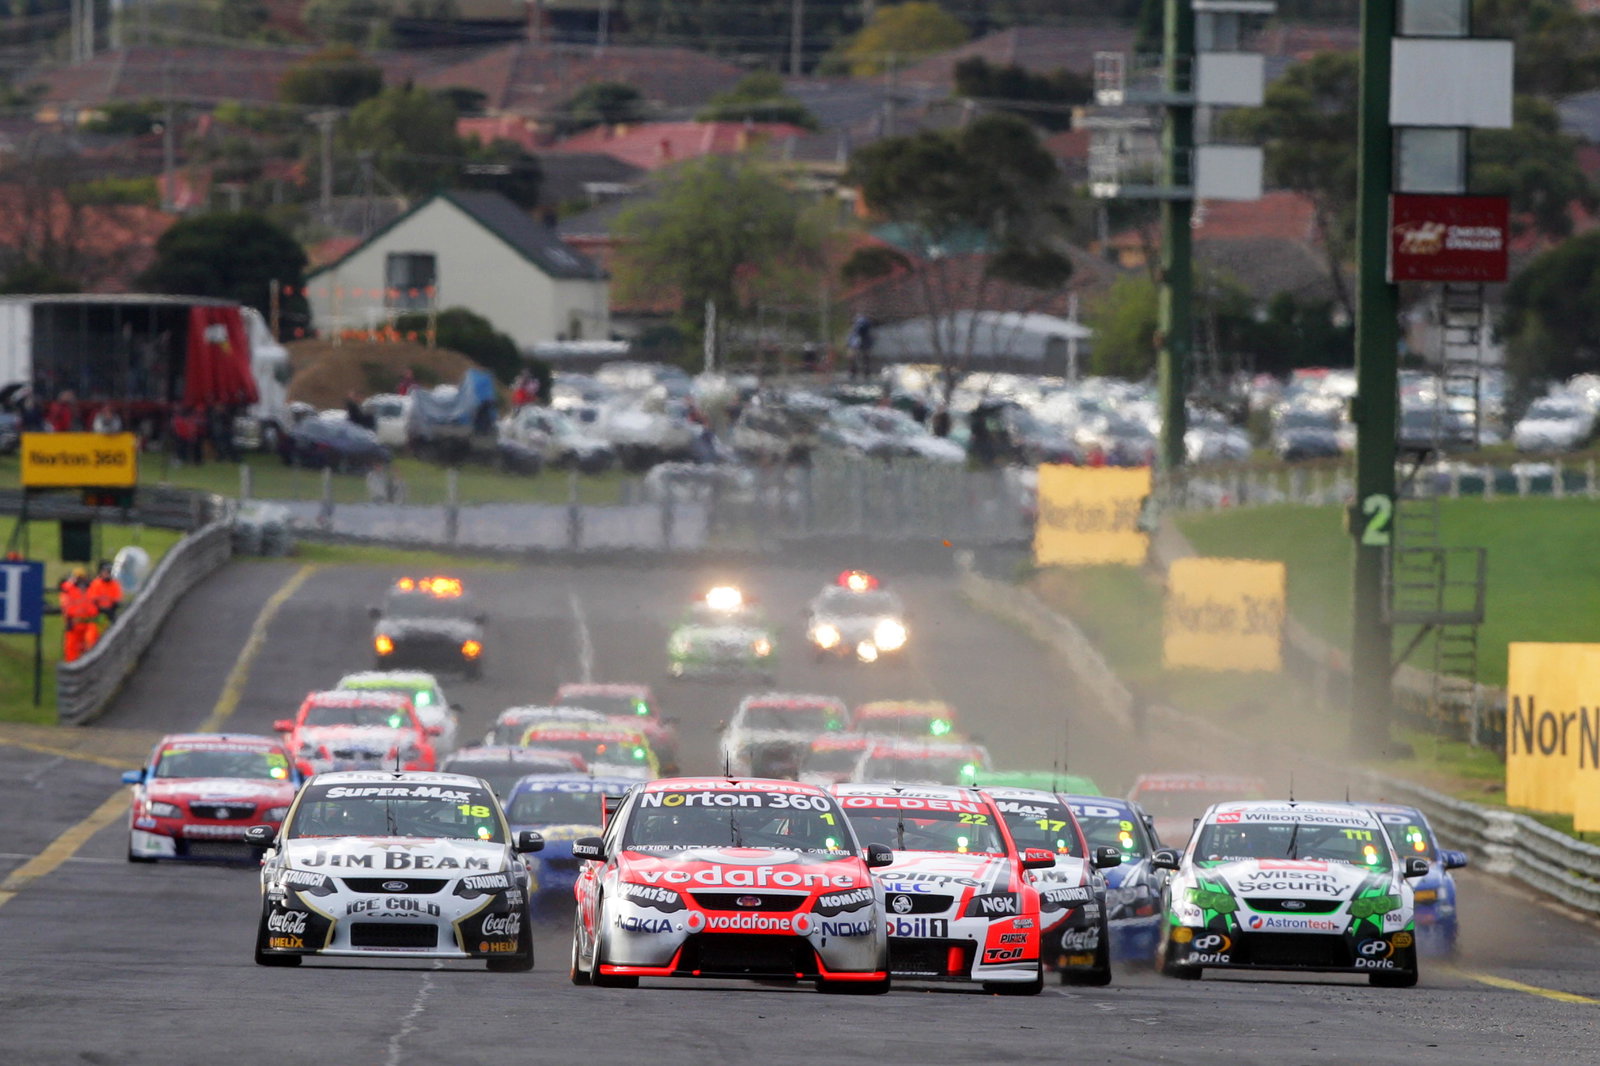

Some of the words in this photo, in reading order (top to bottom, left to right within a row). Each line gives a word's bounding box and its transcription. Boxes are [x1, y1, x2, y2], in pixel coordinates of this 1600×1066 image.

[29, 451, 89, 465] Norton
[1363, 494, 1392, 546] 2
[326, 786, 471, 800] SUPER-MAX
[646, 782, 822, 796] vodafone
[640, 791, 762, 808] Norton
[766, 792, 831, 812] 360
[457, 804, 491, 818] 18
[820, 812, 836, 827] 1
[958, 812, 989, 826] 22
[1035, 819, 1067, 832] 17
[1119, 820, 1134, 832] 9
[1245, 813, 1301, 822] Wilson
[1304, 814, 1370, 827] Security
[1343, 829, 1373, 842] 111
[301, 850, 375, 868] JIM
[383, 851, 490, 870] BEAM
[1027, 852, 1052, 860] NEC
[282, 869, 327, 887] STAUNCH
[463, 874, 509, 889] STAUNCH
[639, 865, 854, 888] vodafone
[1248, 870, 1338, 883] Wilson
[619, 882, 678, 904] KOMATSU
[1045, 888, 1089, 902] STAUNCH
[1238, 880, 1345, 897] Security
[346, 898, 380, 916] ICE
[386, 897, 440, 917] COLD
[981, 897, 1016, 913] NGK
[708, 913, 790, 931] vodafone
[1265, 916, 1336, 932] Astrontech
[274, 934, 304, 948] HELIX
[986, 948, 1024, 960] Toll
[1188, 951, 1230, 963] Doric
[1355, 957, 1394, 969] Doric
